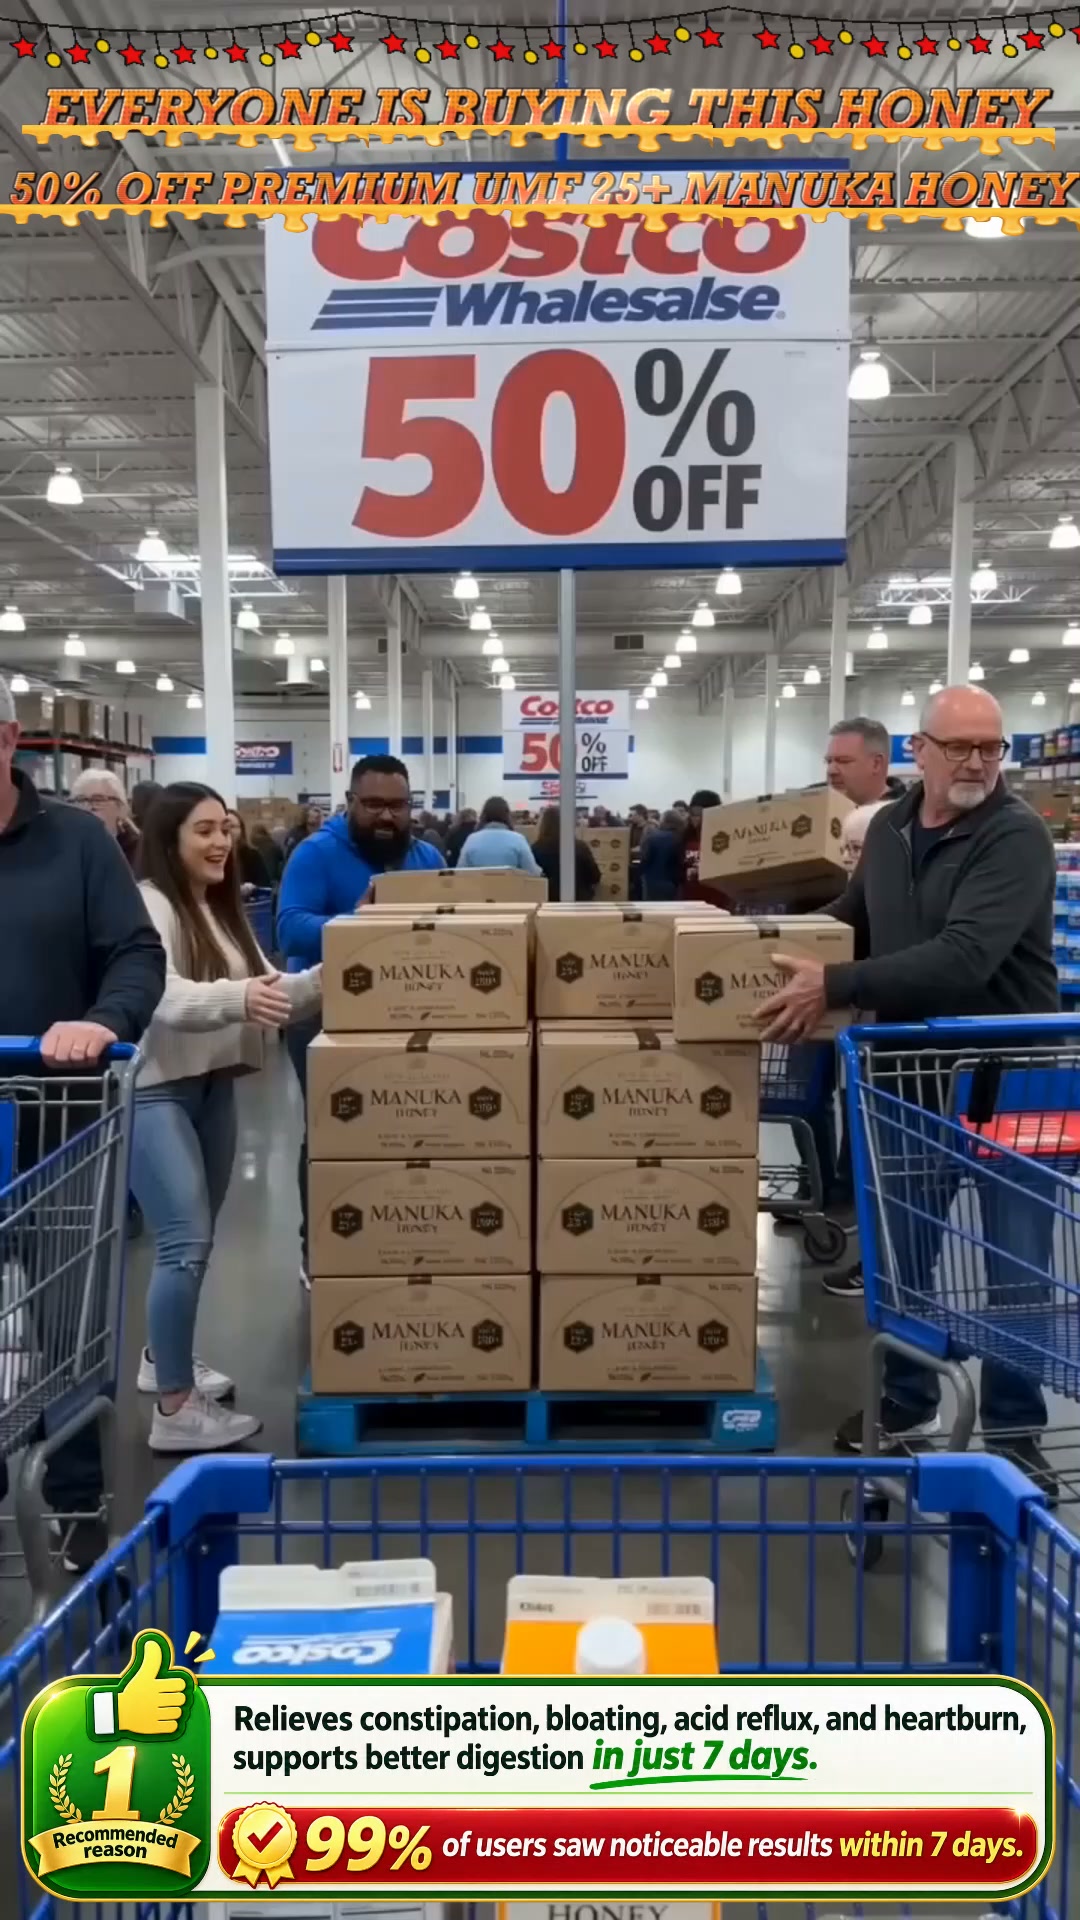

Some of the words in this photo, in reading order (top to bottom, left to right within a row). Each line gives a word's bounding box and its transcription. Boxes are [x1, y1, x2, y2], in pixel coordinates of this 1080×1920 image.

[445, 276, 781, 327] Whalesalse
[351, 348, 626, 538] 50
[634, 348, 756, 458] %
[632, 464, 762, 532] OFF
[520, 695, 614, 716] Coco
[582, 756, 607, 772] OFF
[590, 954, 670, 970] MANUKA
[379, 964, 465, 982] MANUKA
[730, 972, 793, 989] MAN
[371, 1089, 462, 1106] MANUKA
[603, 1087, 694, 1105] MANUKA
[370, 1205, 464, 1222] MANUKA
[601, 1203, 691, 1221] MANUKA
[372, 1322, 465, 1339] MANUKA
[601, 1322, 691, 1339] MANUKA
[232, 1640, 393, 1665] Costco
